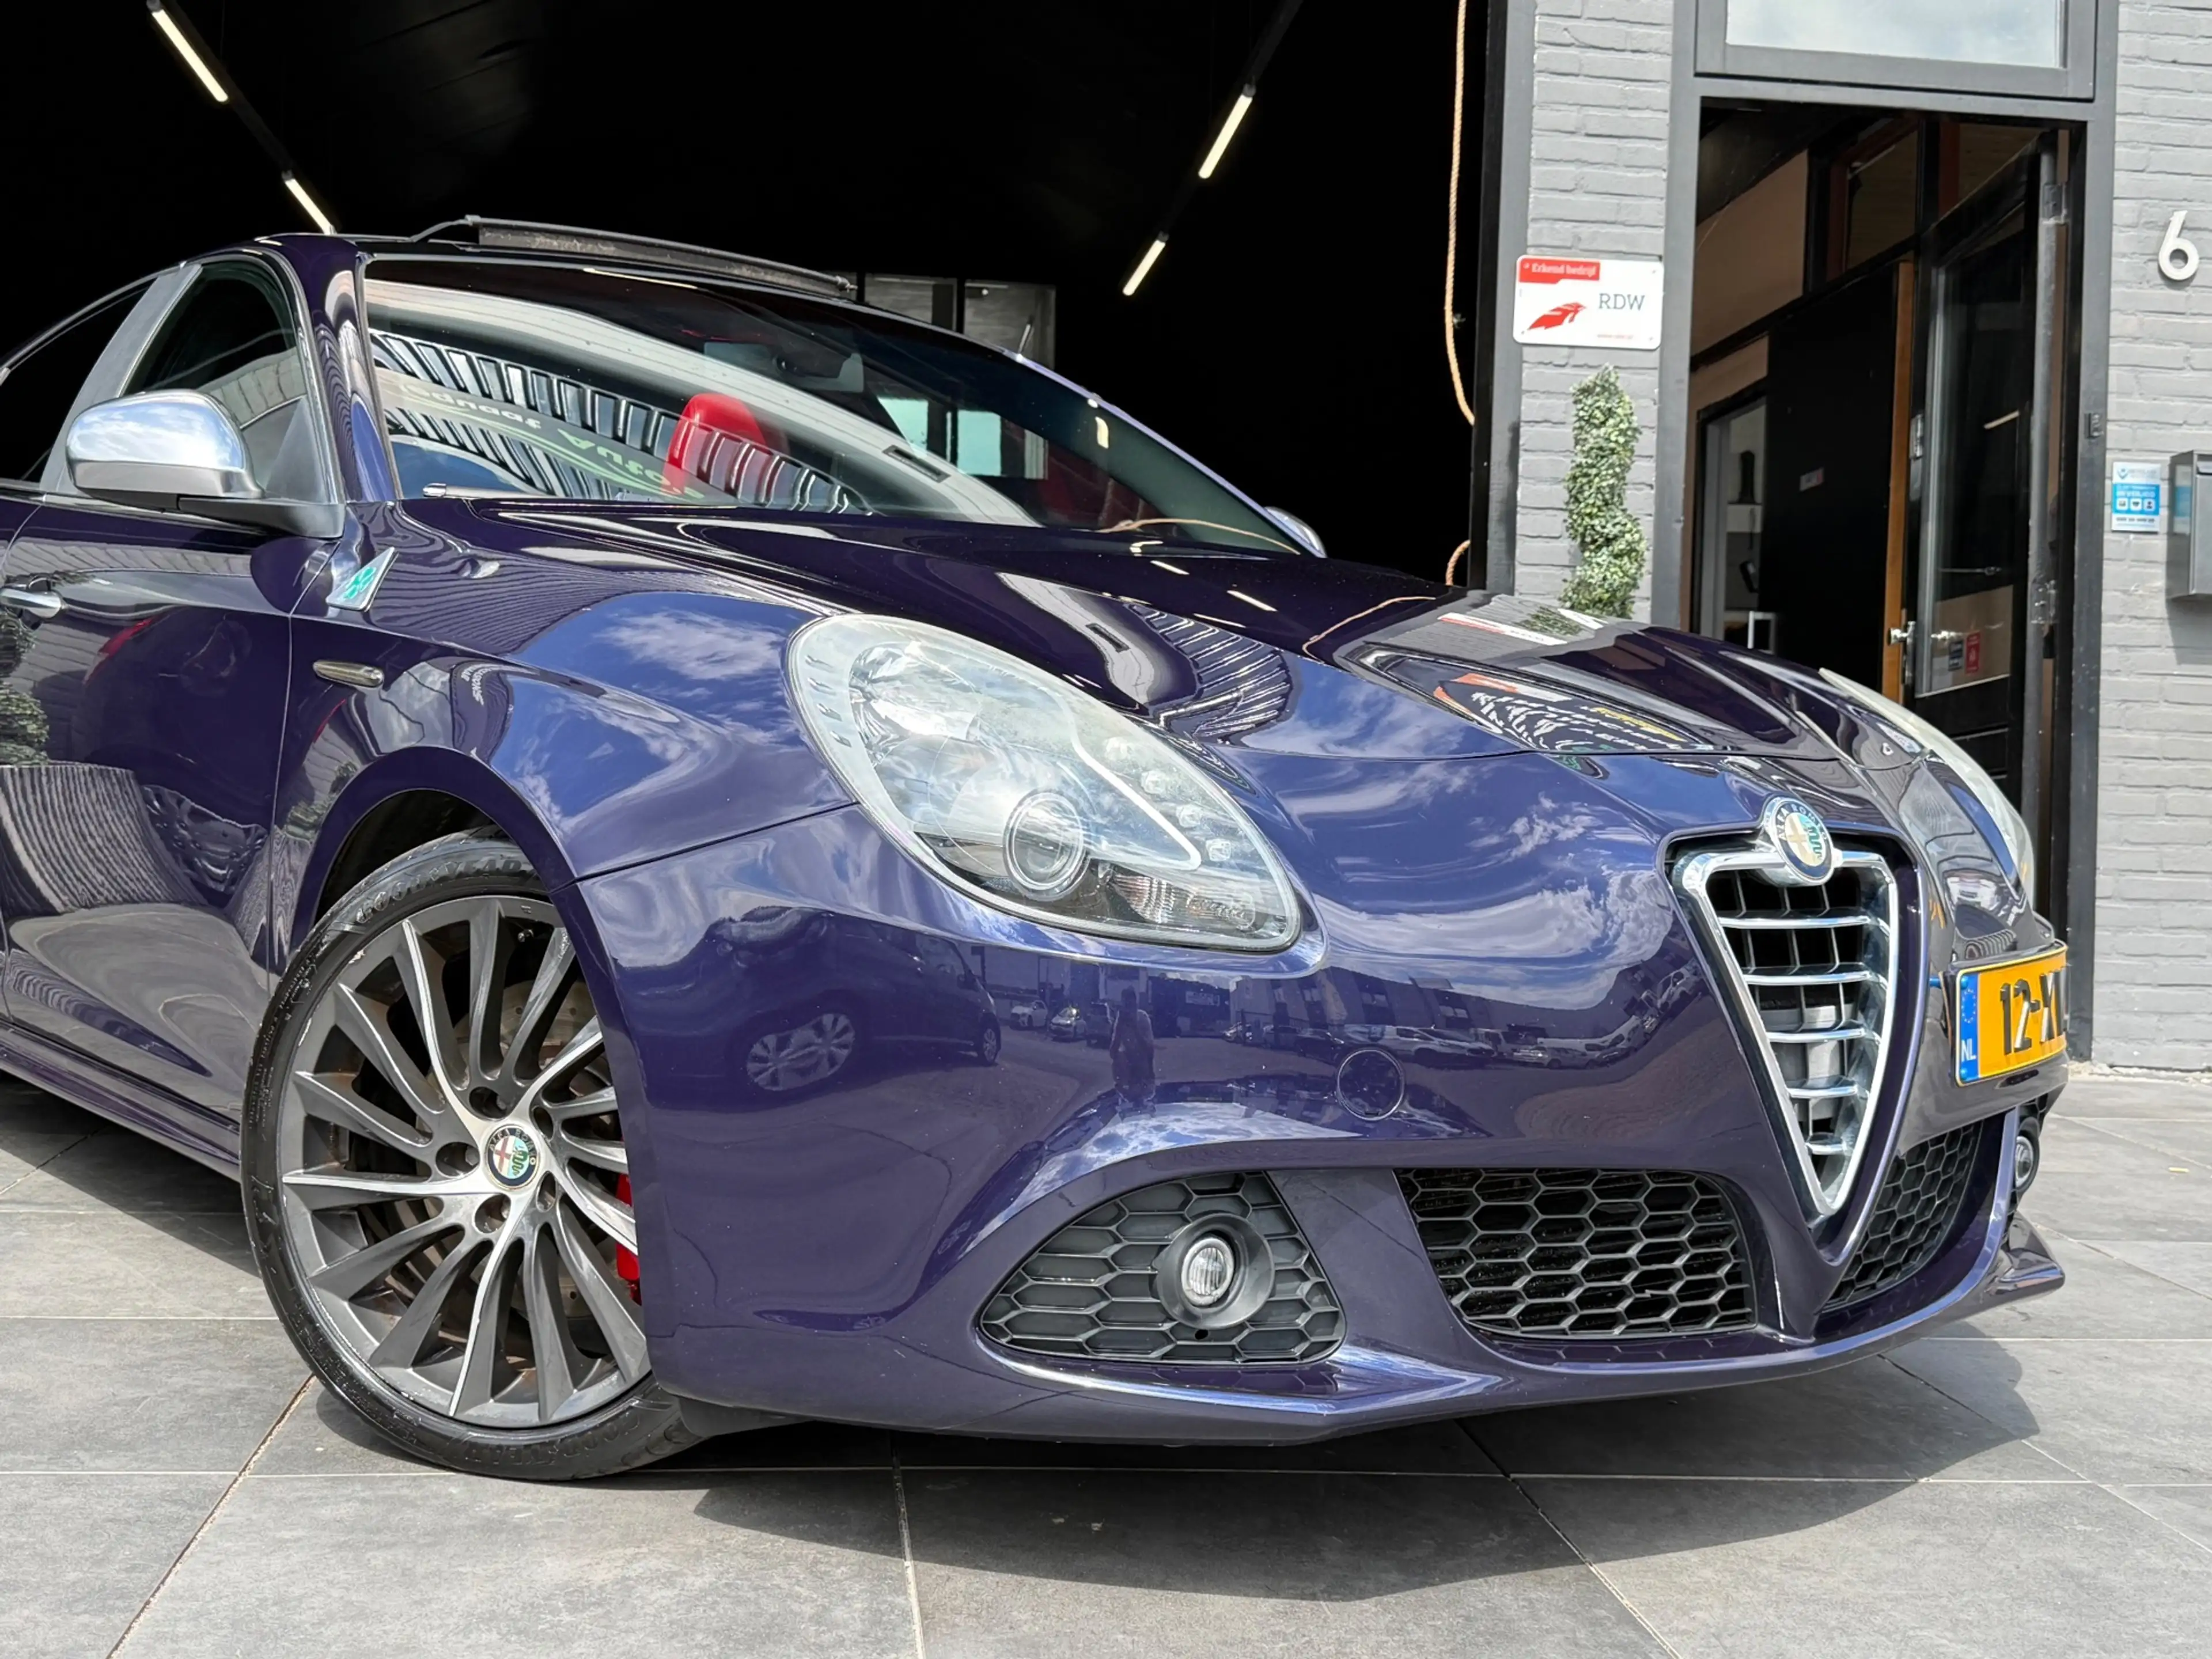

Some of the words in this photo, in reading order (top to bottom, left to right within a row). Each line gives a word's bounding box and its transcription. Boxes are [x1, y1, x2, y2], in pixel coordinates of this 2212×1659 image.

[2158, 210, 2199, 280] 6
[1598, 293, 1645, 310] RDW
[1961, 1038, 1976, 1062] NL
